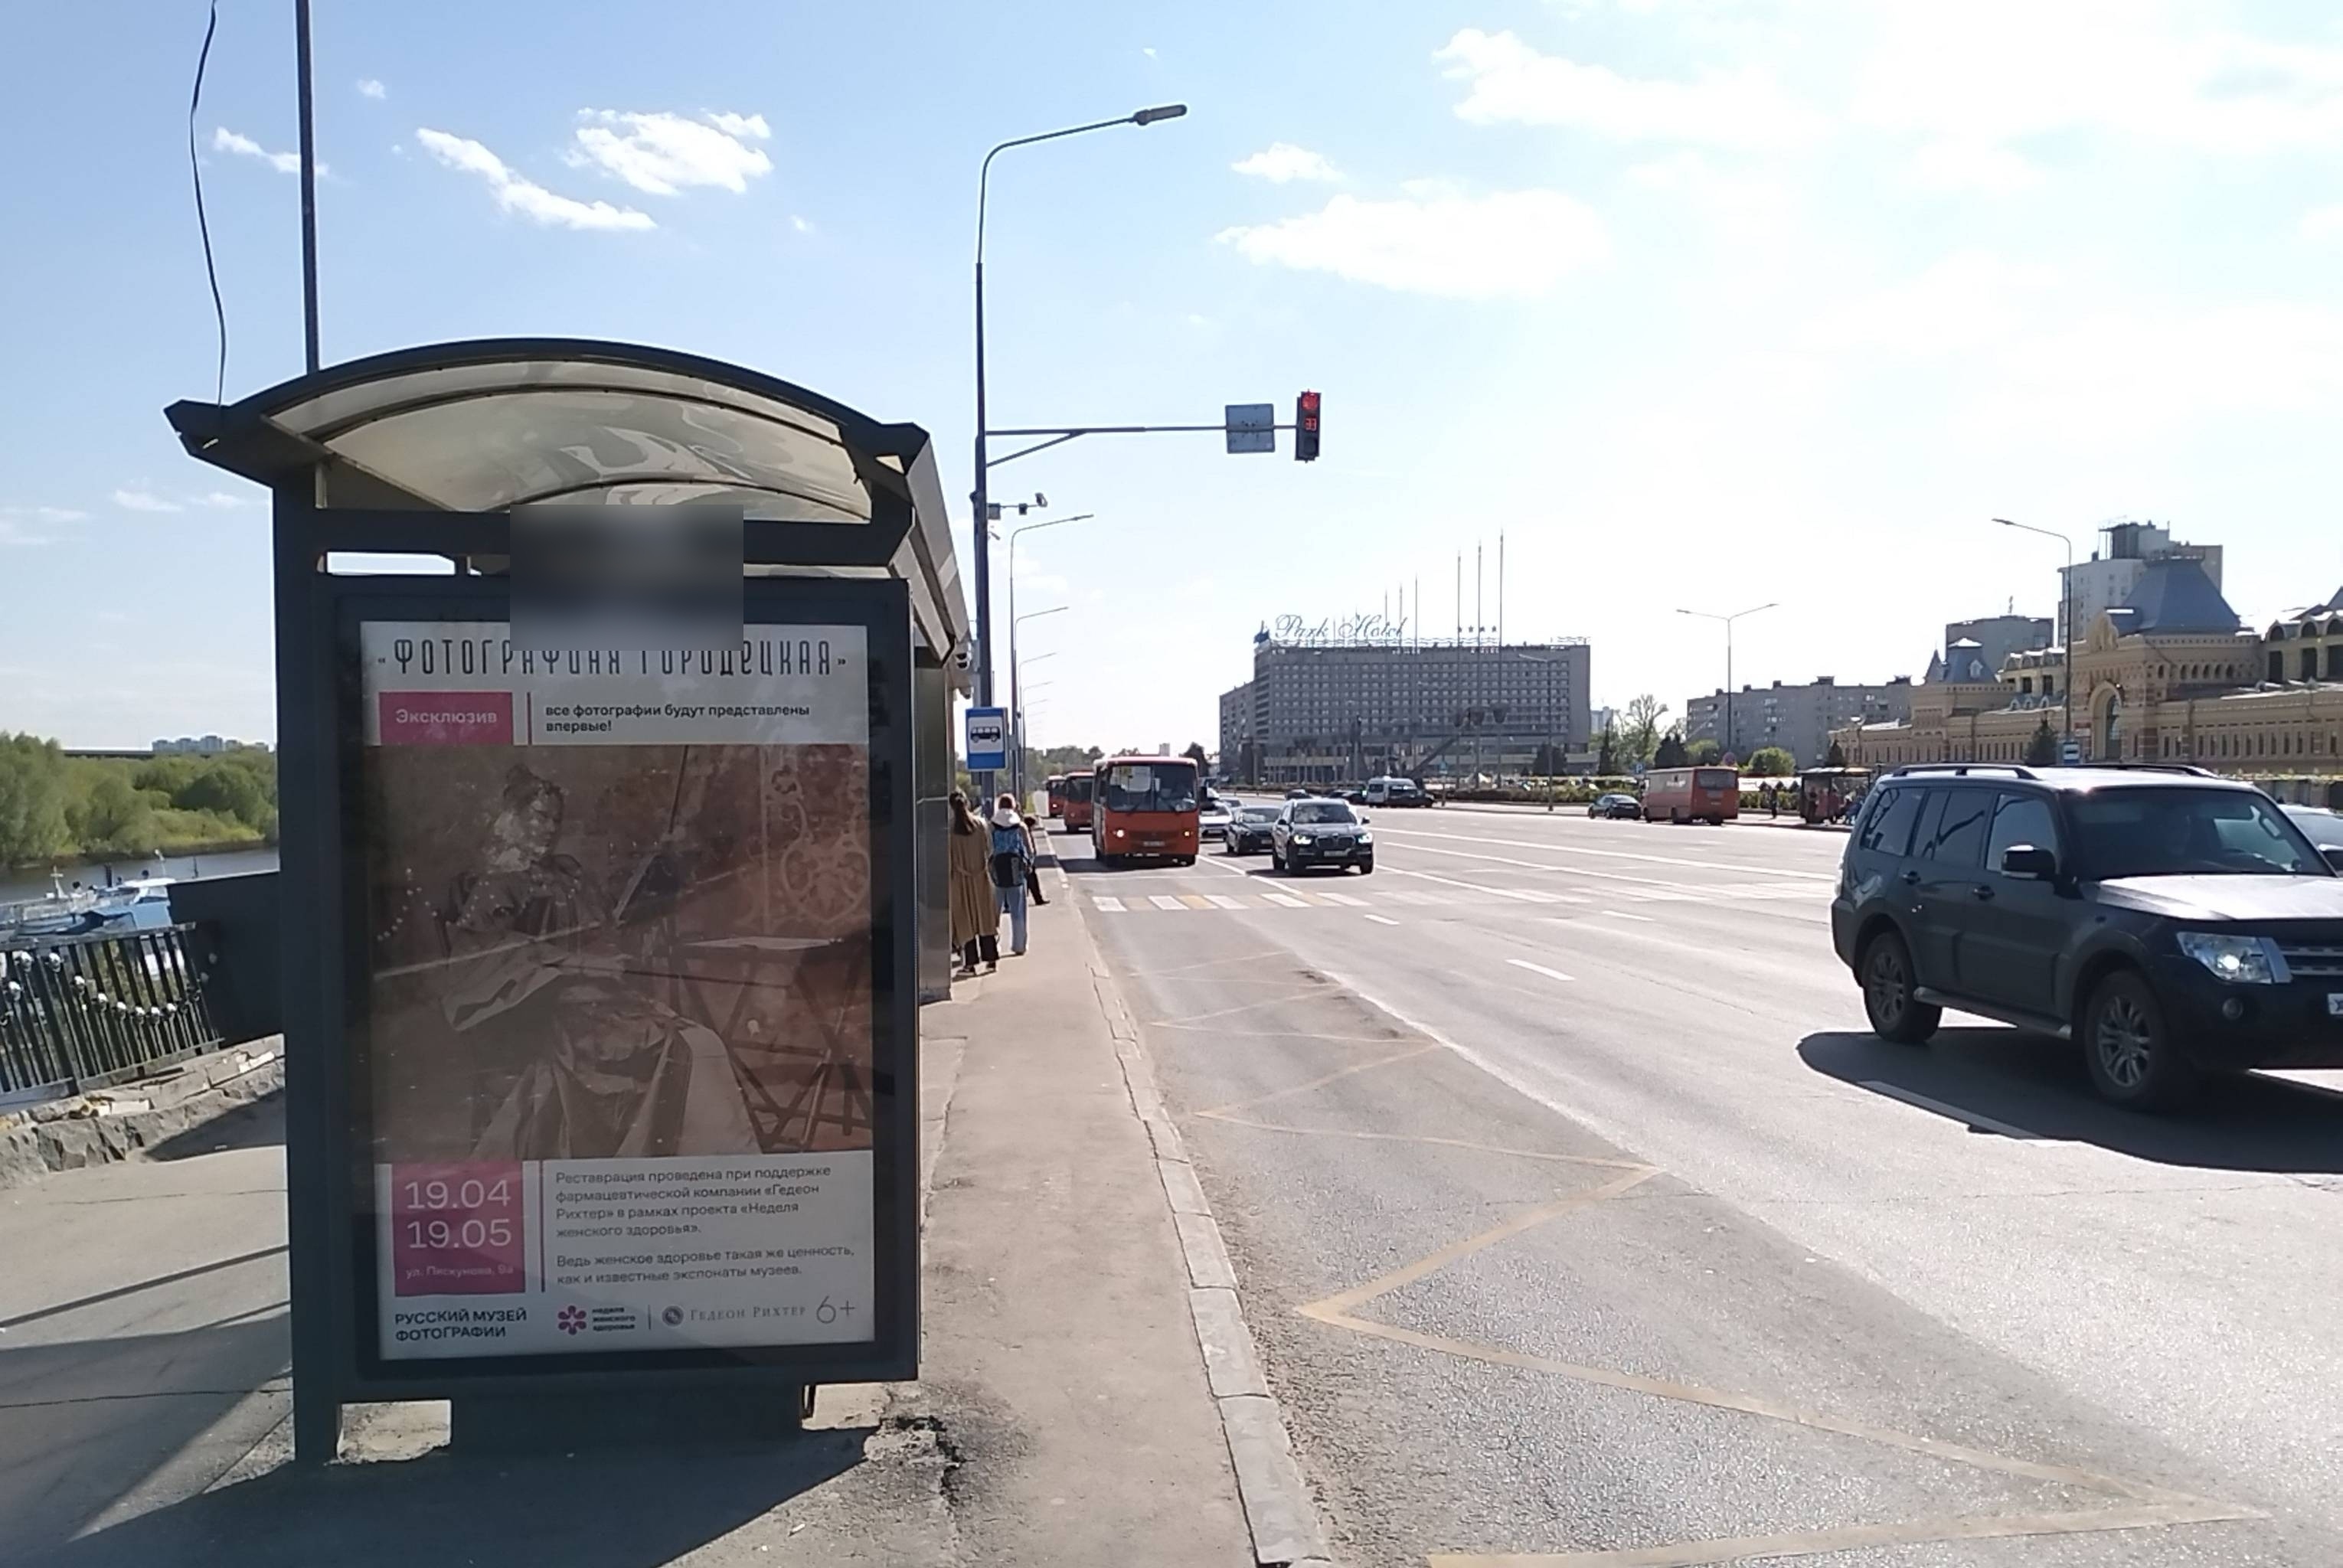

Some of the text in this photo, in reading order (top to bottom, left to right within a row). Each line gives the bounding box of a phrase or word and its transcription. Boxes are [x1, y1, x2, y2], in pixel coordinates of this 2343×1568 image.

[1276, 614, 1407, 638] Park Hotel
[395, 708, 497, 724] Эксклюзив
[546, 704, 810, 718] все фотографии будут представлены
[546, 720, 612, 733] впервые!
[556, 1167, 832, 1184] Реставрация проведена при поддержке
[404, 1179, 511, 1210] 19.04
[694, 1187, 761, 1198] компании
[765, 1184, 820, 1196] «Гедеон
[556, 1202, 799, 1220] Рихтер» в рамках проекта «Неделя
[407, 1218, 511, 1249] 19.05
[556, 1225, 701, 1237] женского здоровья».
[557, 1246, 855, 1268] Ведь женское здоровье такая же ценность,
[557, 1265, 802, 1285] как и известные экспонаты музеев.
[394, 1307, 528, 1325] РУССКИЙ МУЗЕЙ
[815, 1295, 856, 1325] 6+
[395, 1326, 506, 1341] ФОТОГРАФИИ
